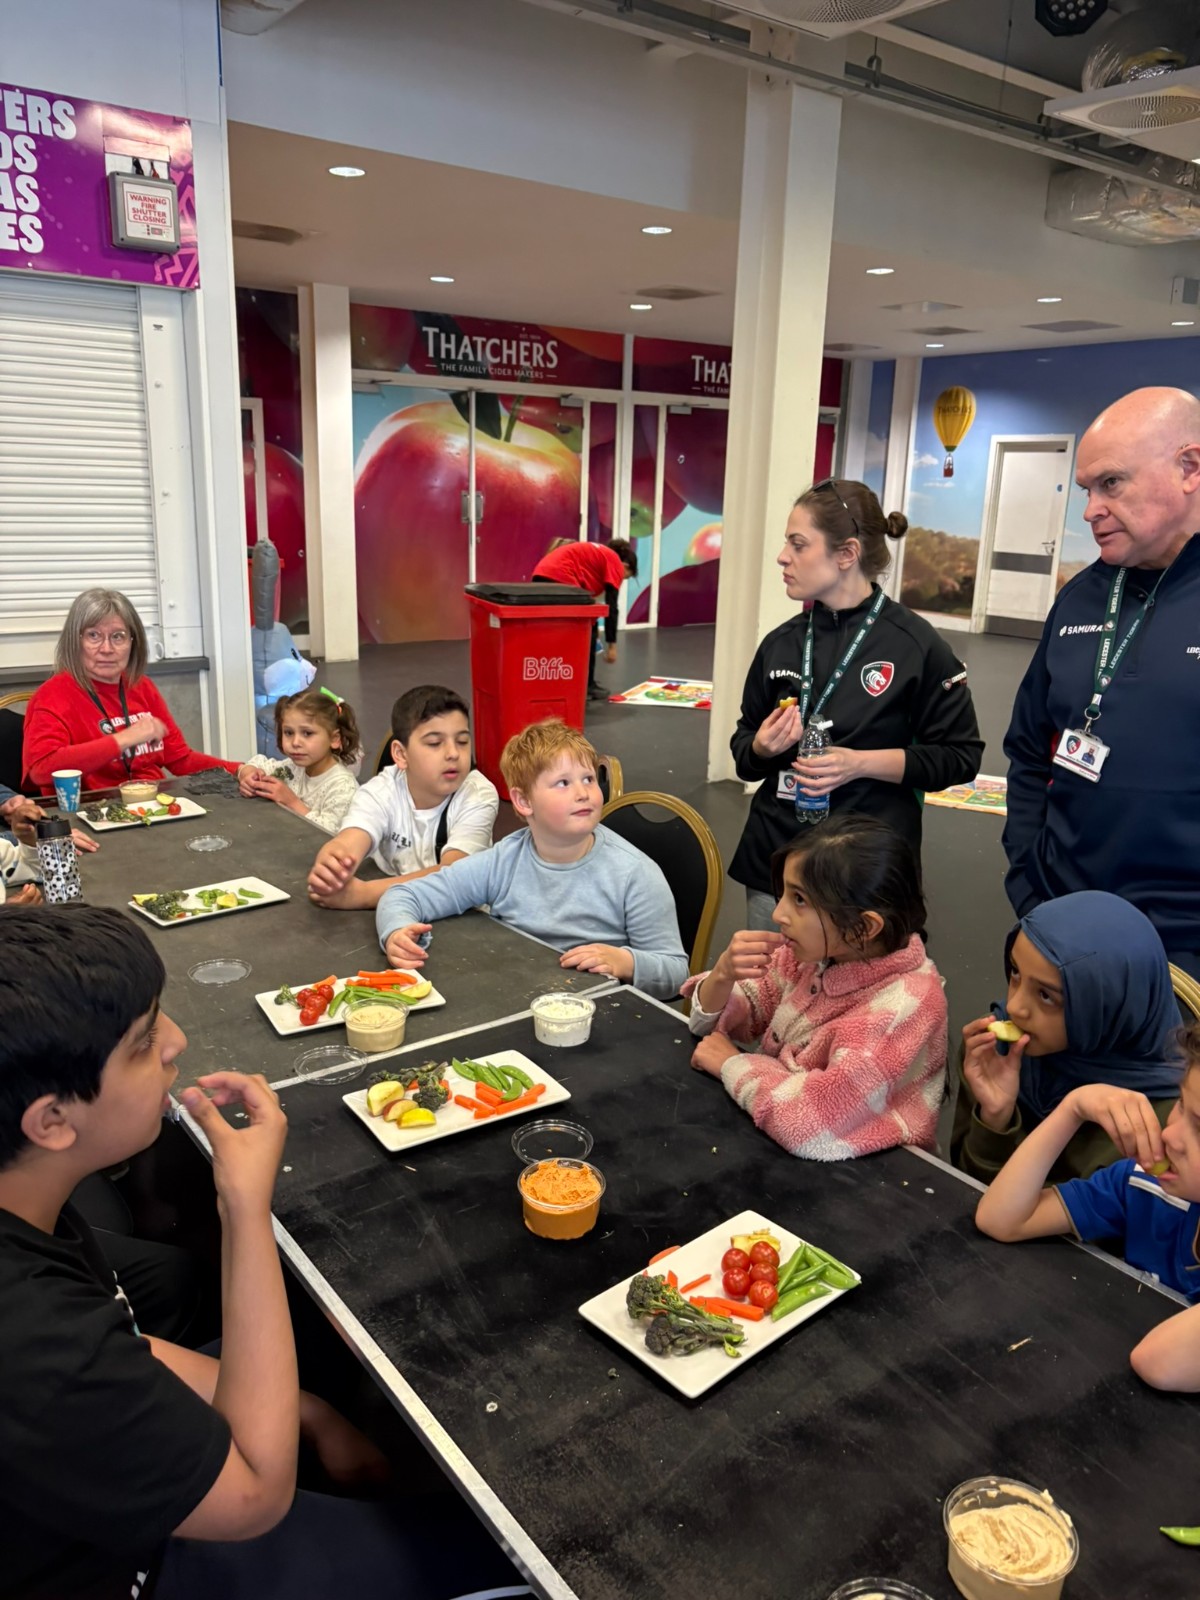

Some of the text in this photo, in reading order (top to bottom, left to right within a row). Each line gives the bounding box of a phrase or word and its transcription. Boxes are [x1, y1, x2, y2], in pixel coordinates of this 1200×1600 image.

[0, 88, 76, 139] ERS
[130, 194, 167, 205] WARNING
[141, 202, 157, 210] FIRE
[132, 207, 167, 218] SHUTTER
[133, 214, 167, 224] CLOSING
[0, 211, 44, 254] ES
[422, 326, 558, 369] THATCHERS
[440, 363, 544, 379] THE FAMILY CIDER MAKERS
[691, 355, 731, 384] THA
[1100, 638, 1111, 668] LEICESTER
[523, 656, 574, 681] Biffa
